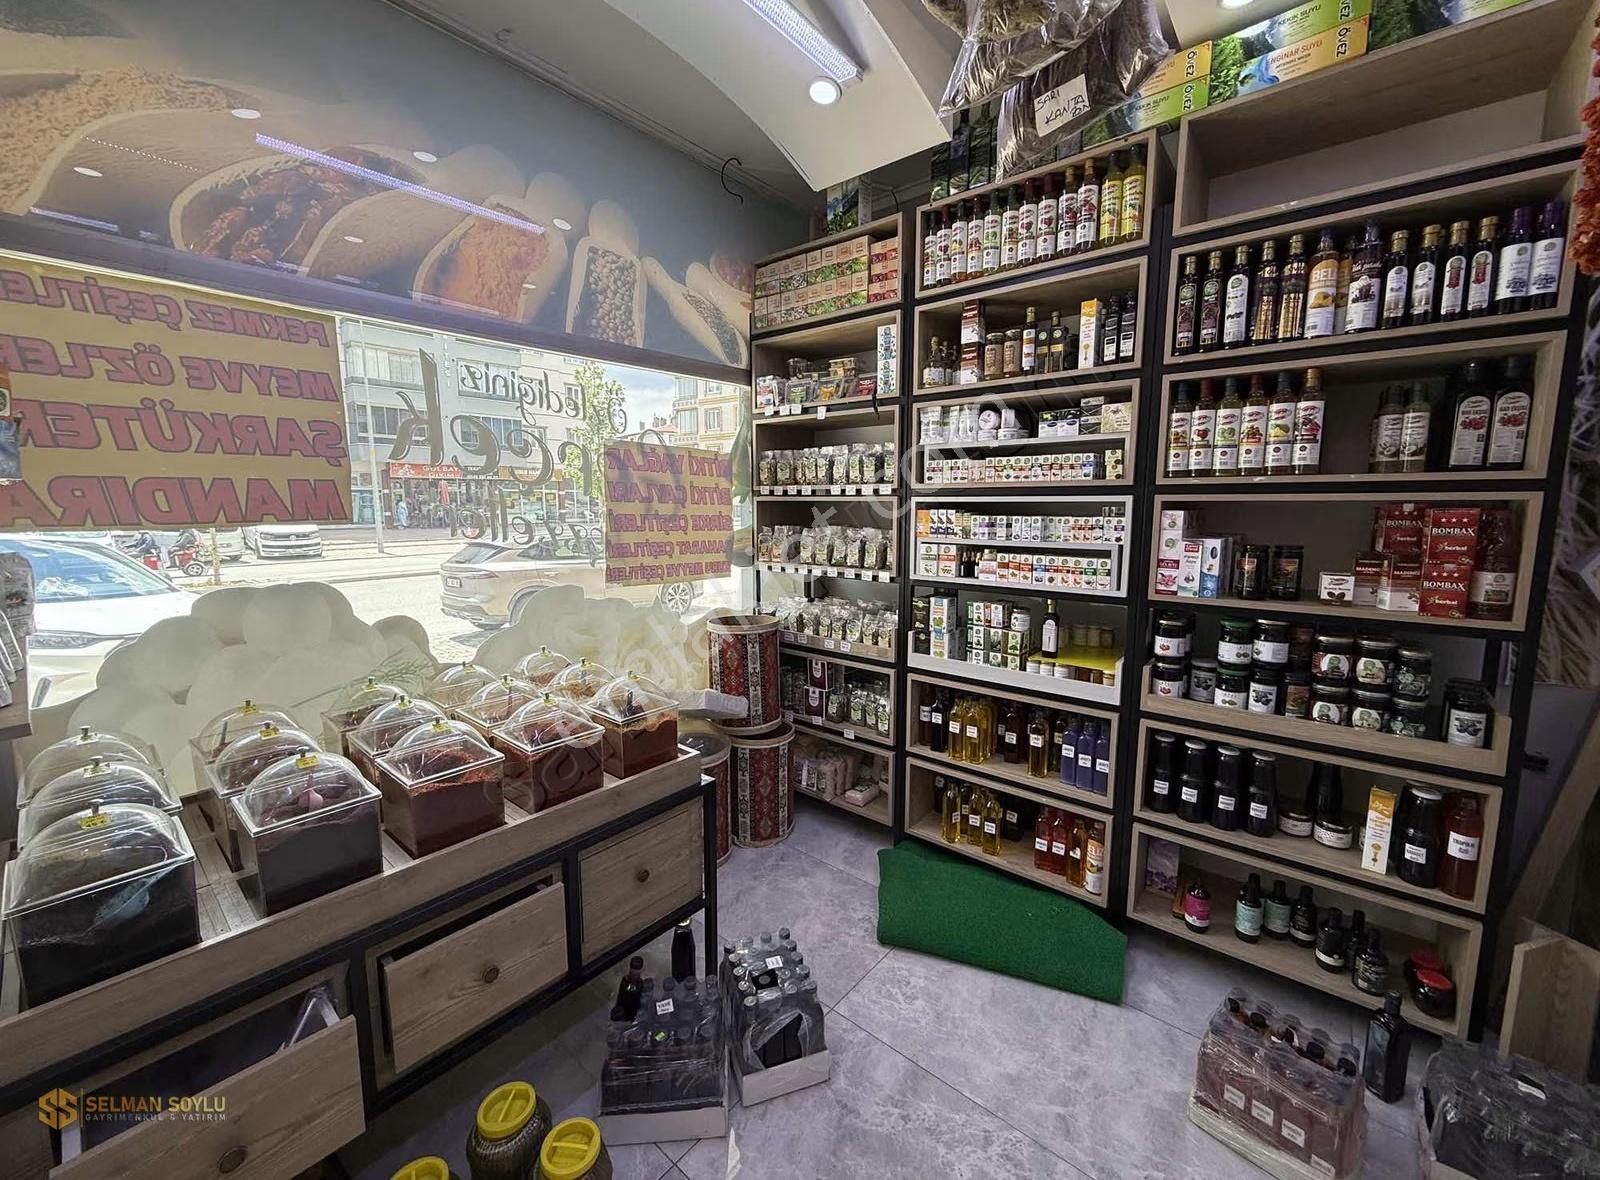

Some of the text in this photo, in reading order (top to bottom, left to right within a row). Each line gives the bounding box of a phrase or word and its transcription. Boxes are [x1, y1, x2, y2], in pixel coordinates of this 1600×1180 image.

[1300, 39, 1323, 54] SUYU
[1336, 27, 1351, 57] ÖVEZ
[1186, 50, 1198, 77] ÖVEZ
[1035, 90, 1060, 112] SARI
[1183, 84, 1195, 111] ÖVEZ
[1386, 519, 1424, 528] BOMBAX
[1432, 527, 1476, 537] BOMBAX
[1423, 581, 1466, 592] BOMBAX
[1435, 598, 1458, 606] herbal
